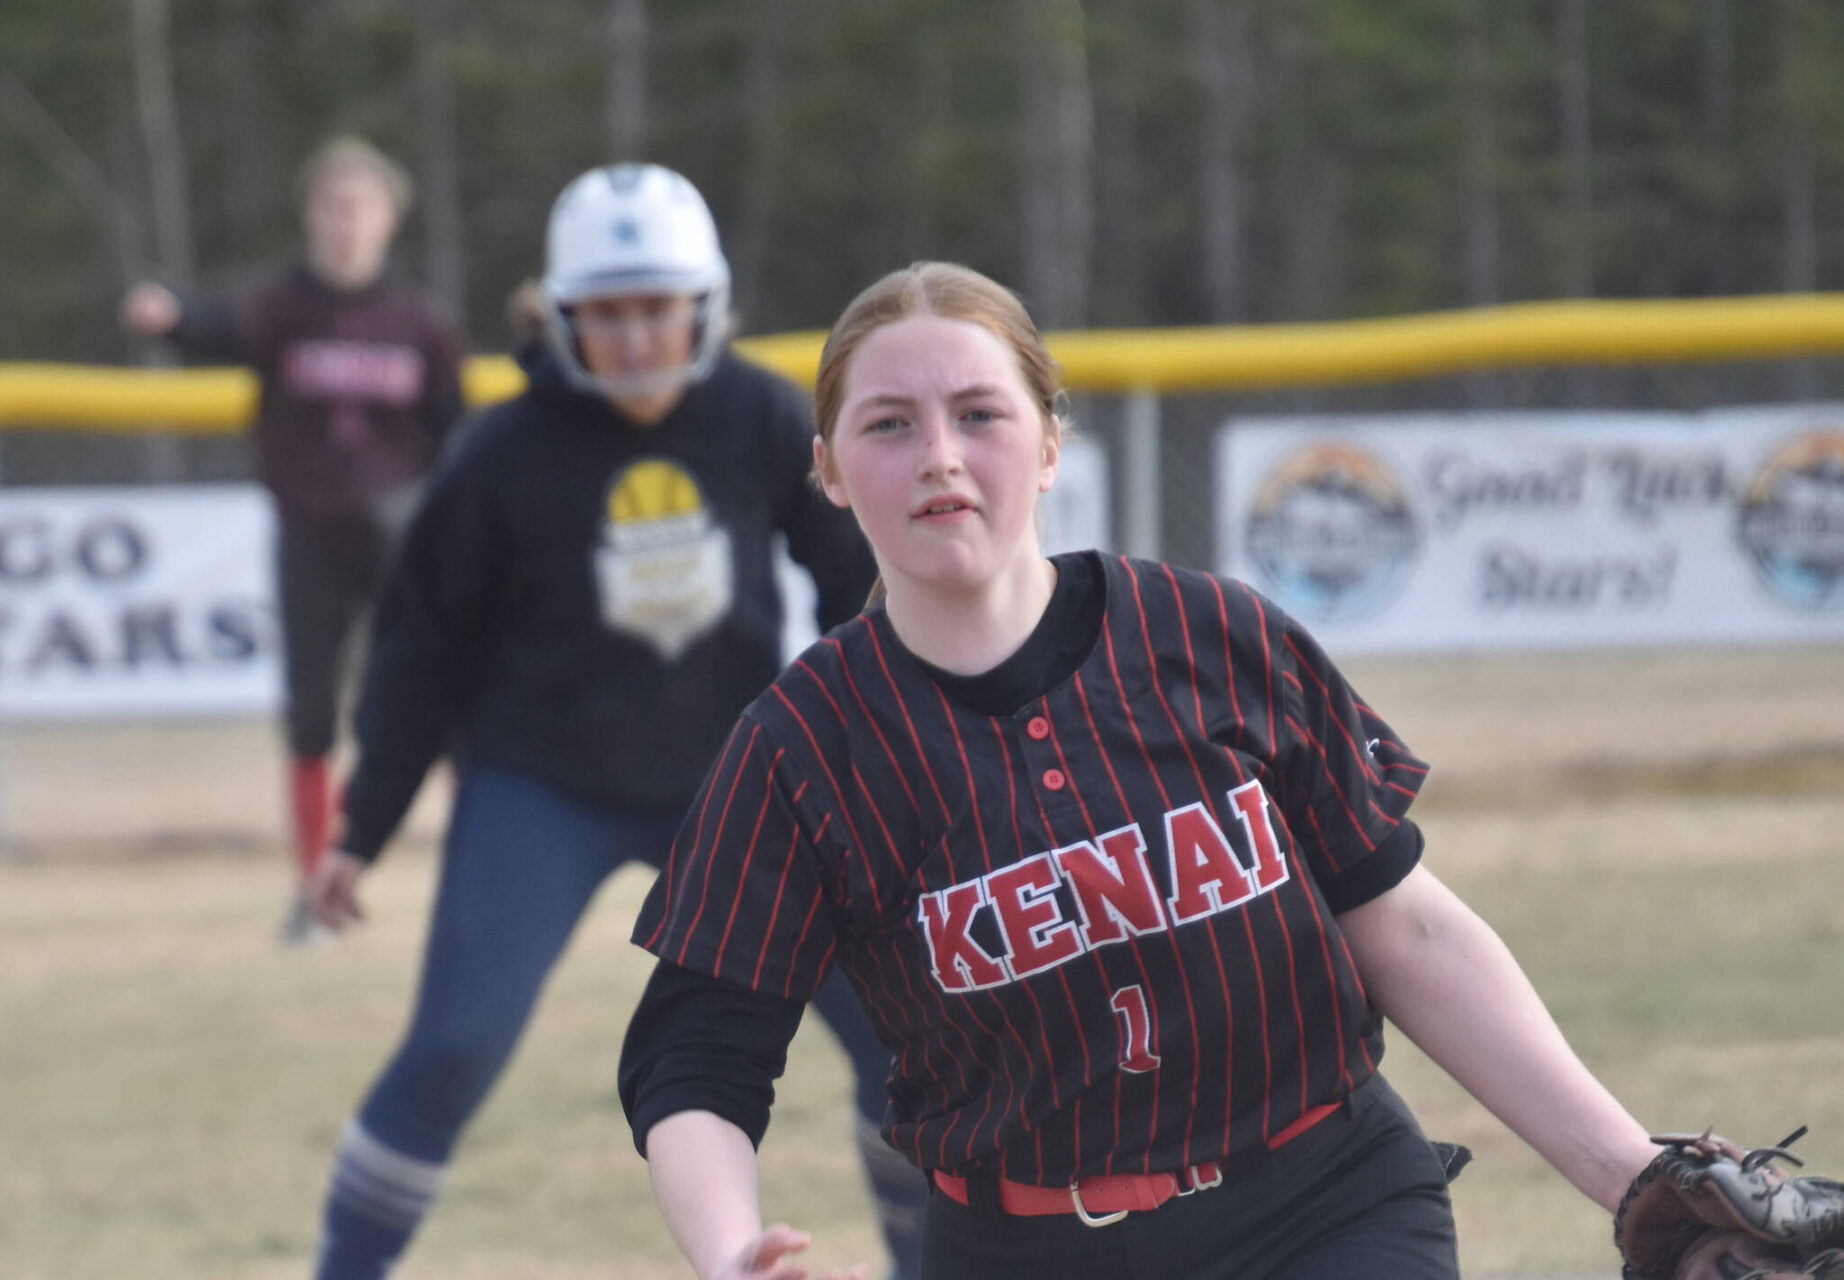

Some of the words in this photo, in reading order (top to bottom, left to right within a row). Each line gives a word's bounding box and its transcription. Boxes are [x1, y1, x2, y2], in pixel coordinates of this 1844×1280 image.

[0, 602, 268, 676] ARS
[918, 778, 1291, 993] KENAI
[1110, 984, 1162, 1073] 1
